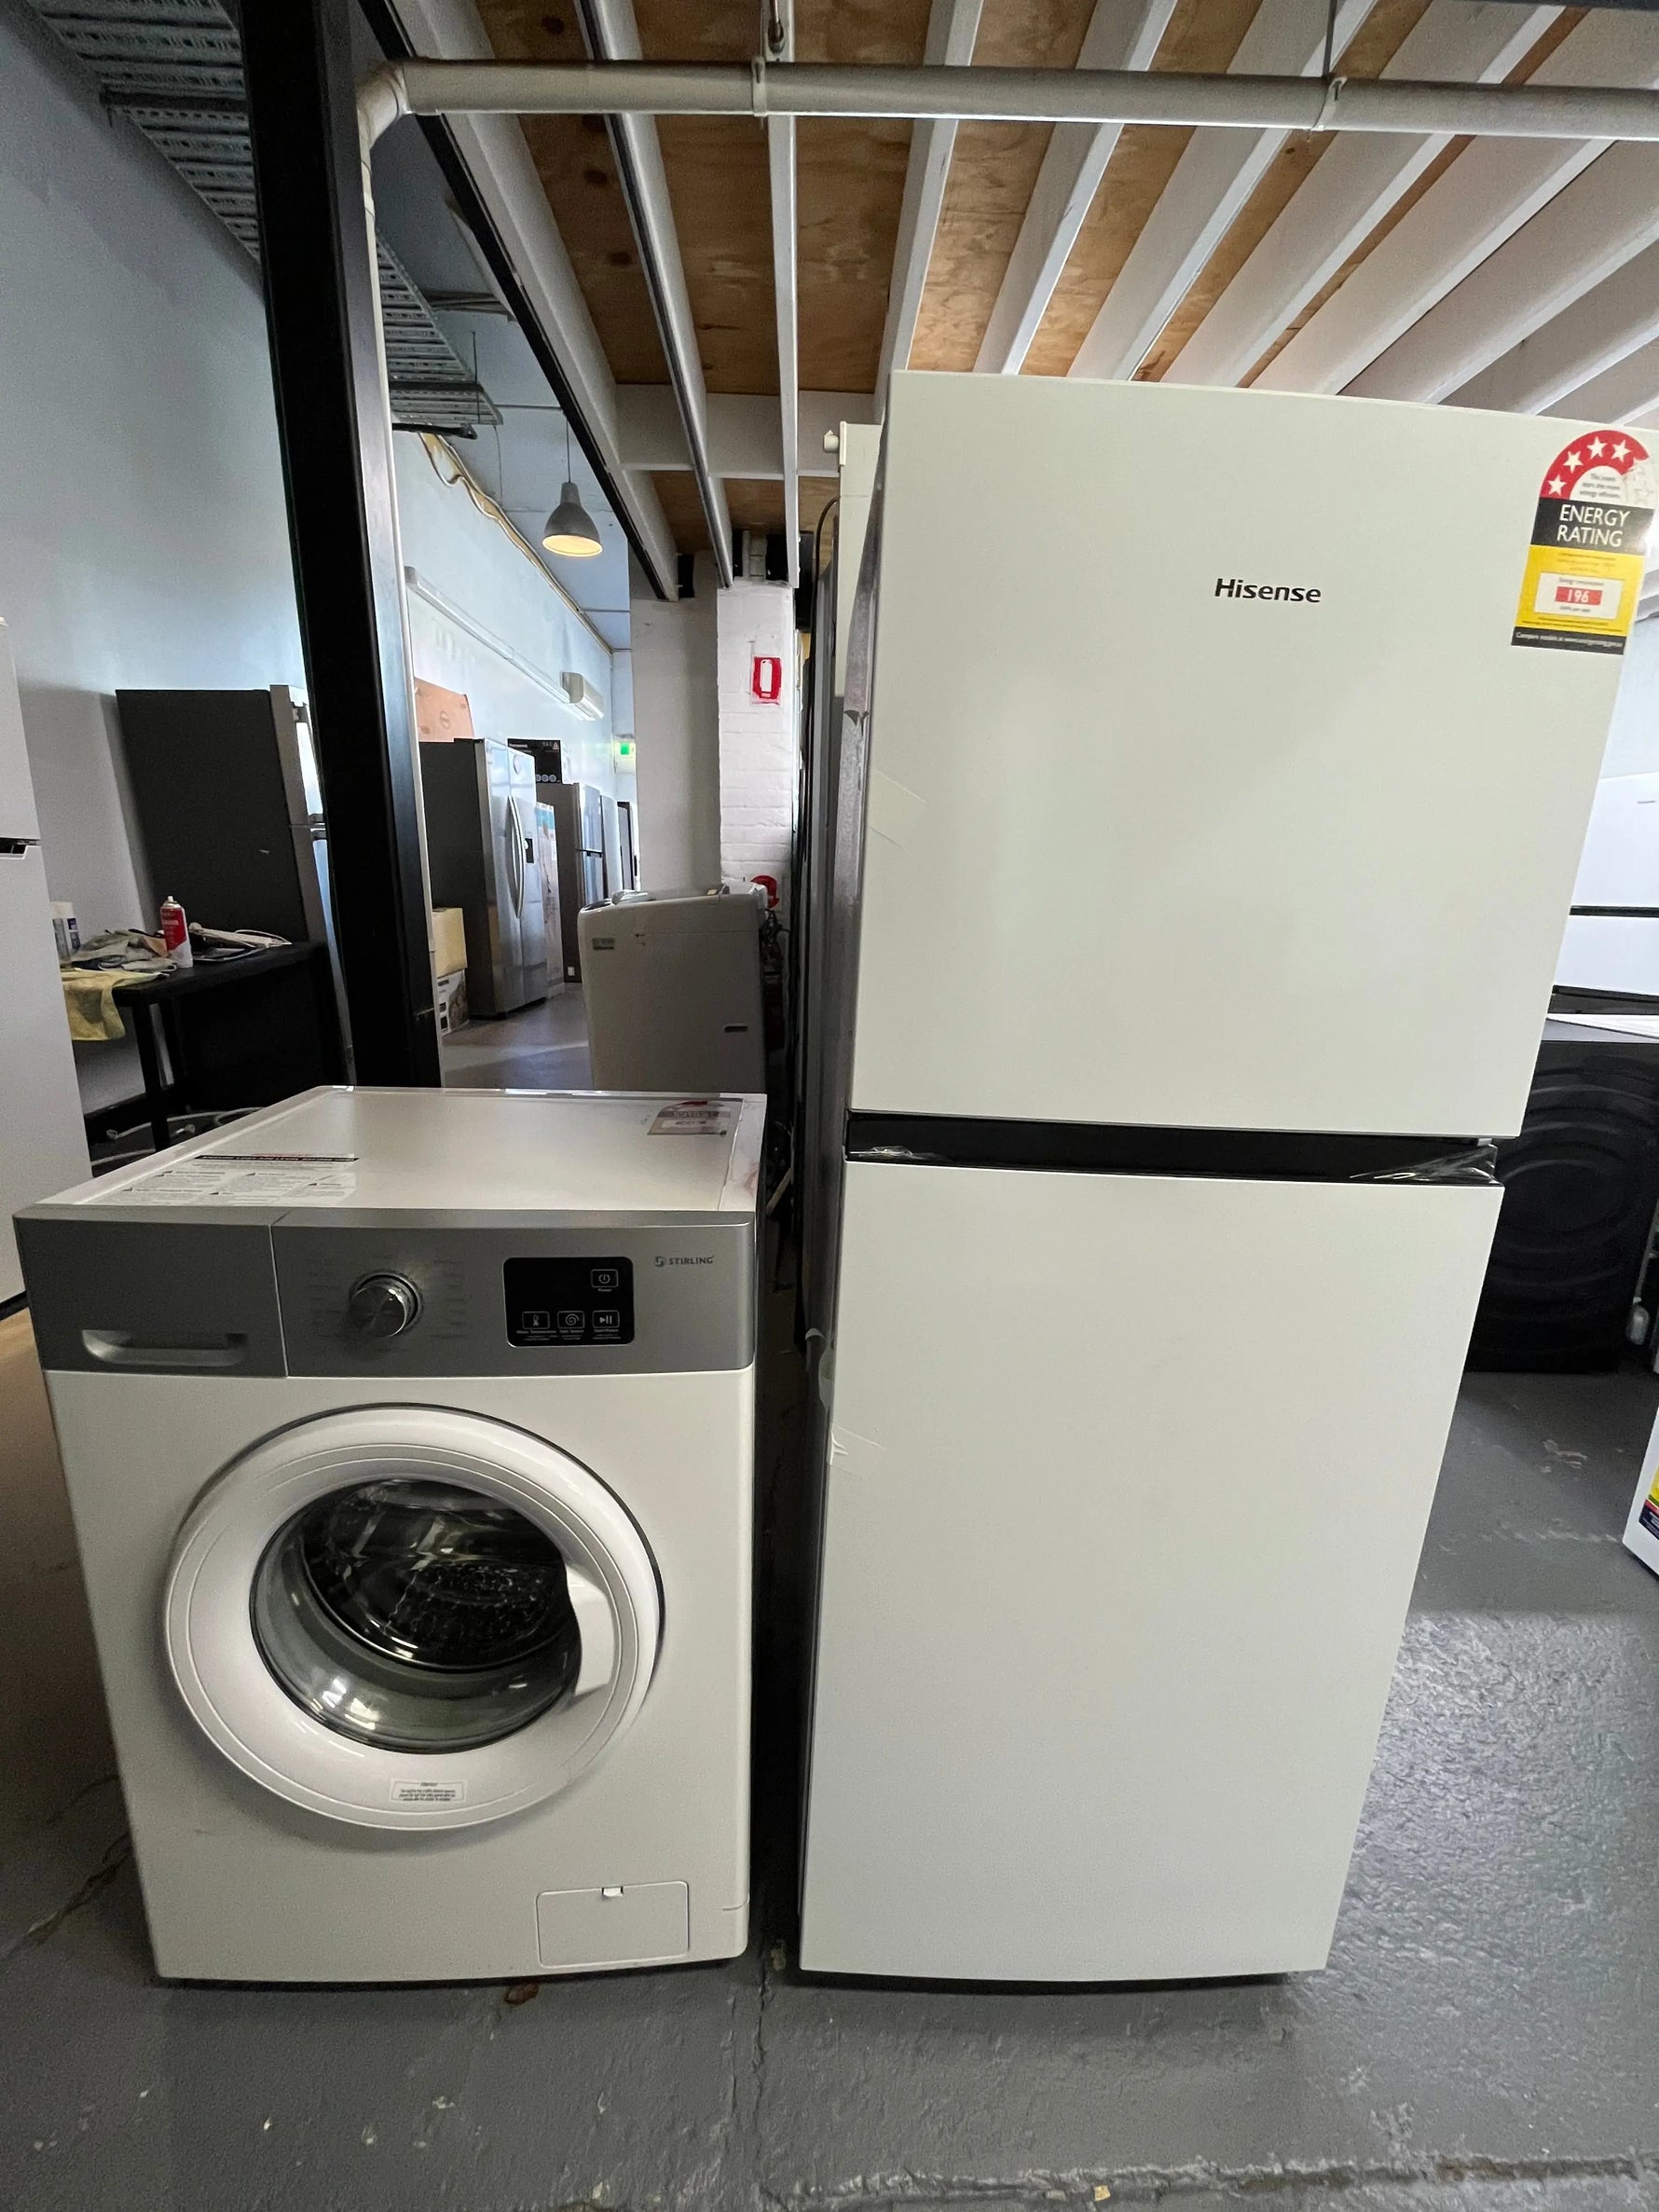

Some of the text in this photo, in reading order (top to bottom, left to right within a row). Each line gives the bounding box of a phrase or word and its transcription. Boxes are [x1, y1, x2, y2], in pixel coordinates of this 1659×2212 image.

[1559, 504, 1630, 527] ENERGY
[1556, 524, 1623, 547] RATING
[1214, 578, 1321, 603] Hisense
[1567, 588, 1590, 603] 196
[668, 1257, 714, 1265] STIRLING
